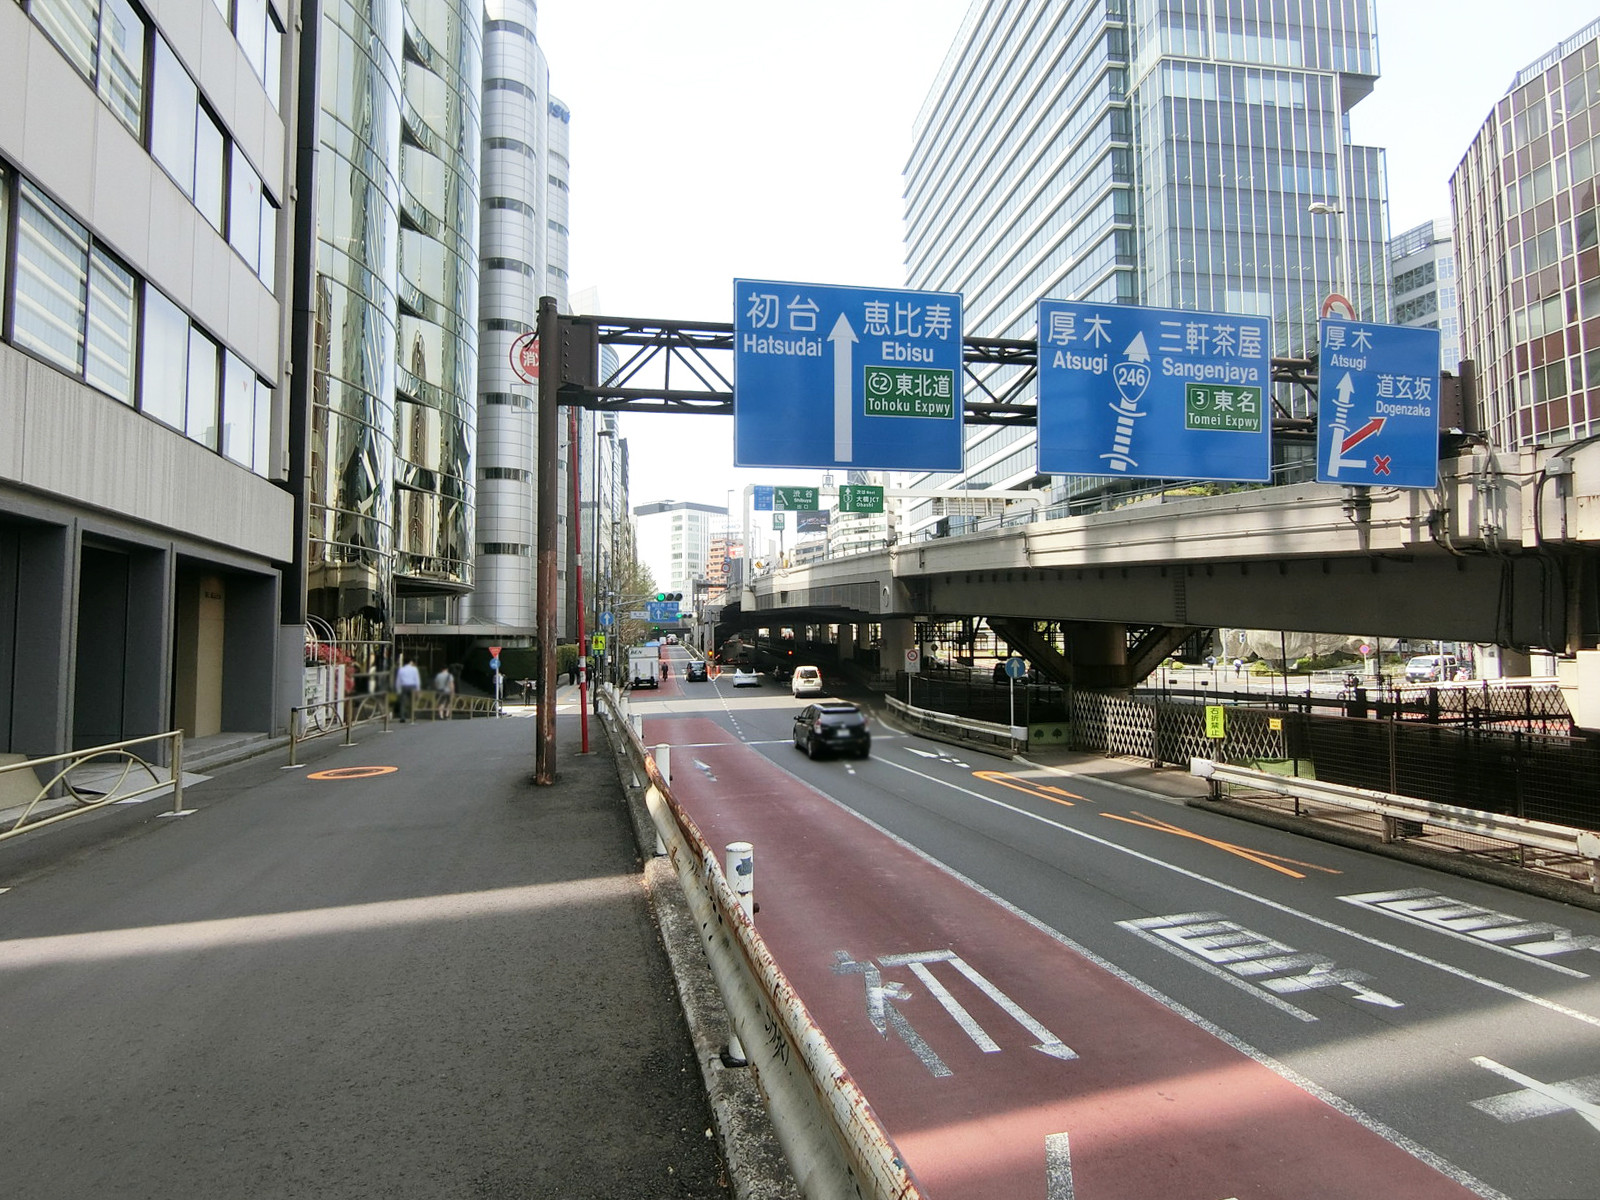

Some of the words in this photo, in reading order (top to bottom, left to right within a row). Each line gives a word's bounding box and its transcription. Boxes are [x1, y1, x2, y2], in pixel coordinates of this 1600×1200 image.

[746, 291, 820, 332] 初台
[863, 299, 952, 341] 恵比寿
[1047, 310, 1112, 349] 厚木
[1158, 320, 1262, 359] 三軒茶屋
[1324, 325, 1373, 353] 厚木
[743, 333, 822, 357] Hatsudai
[881, 341, 934, 363] Ebisu
[1052, 350, 1108, 375] Atsugi
[1162, 356, 1259, 384] Sangenjaya
[1330, 353, 1367, 372] Atsugi
[895, 372, 951, 398] 東北道
[1118, 367, 1145, 387] 246
[1376, 373, 1432, 401] 道玄坂
[868, 397, 910, 412] Tohoku
[915, 400, 951, 416] Expwy
[1195, 391, 1204, 405] 3
[1213, 390, 1255, 413] 東名
[1375, 400, 1431, 417] Dogenzaka
[1188, 411, 1221, 426] Tomei
[1225, 413, 1259, 430] Expwy
